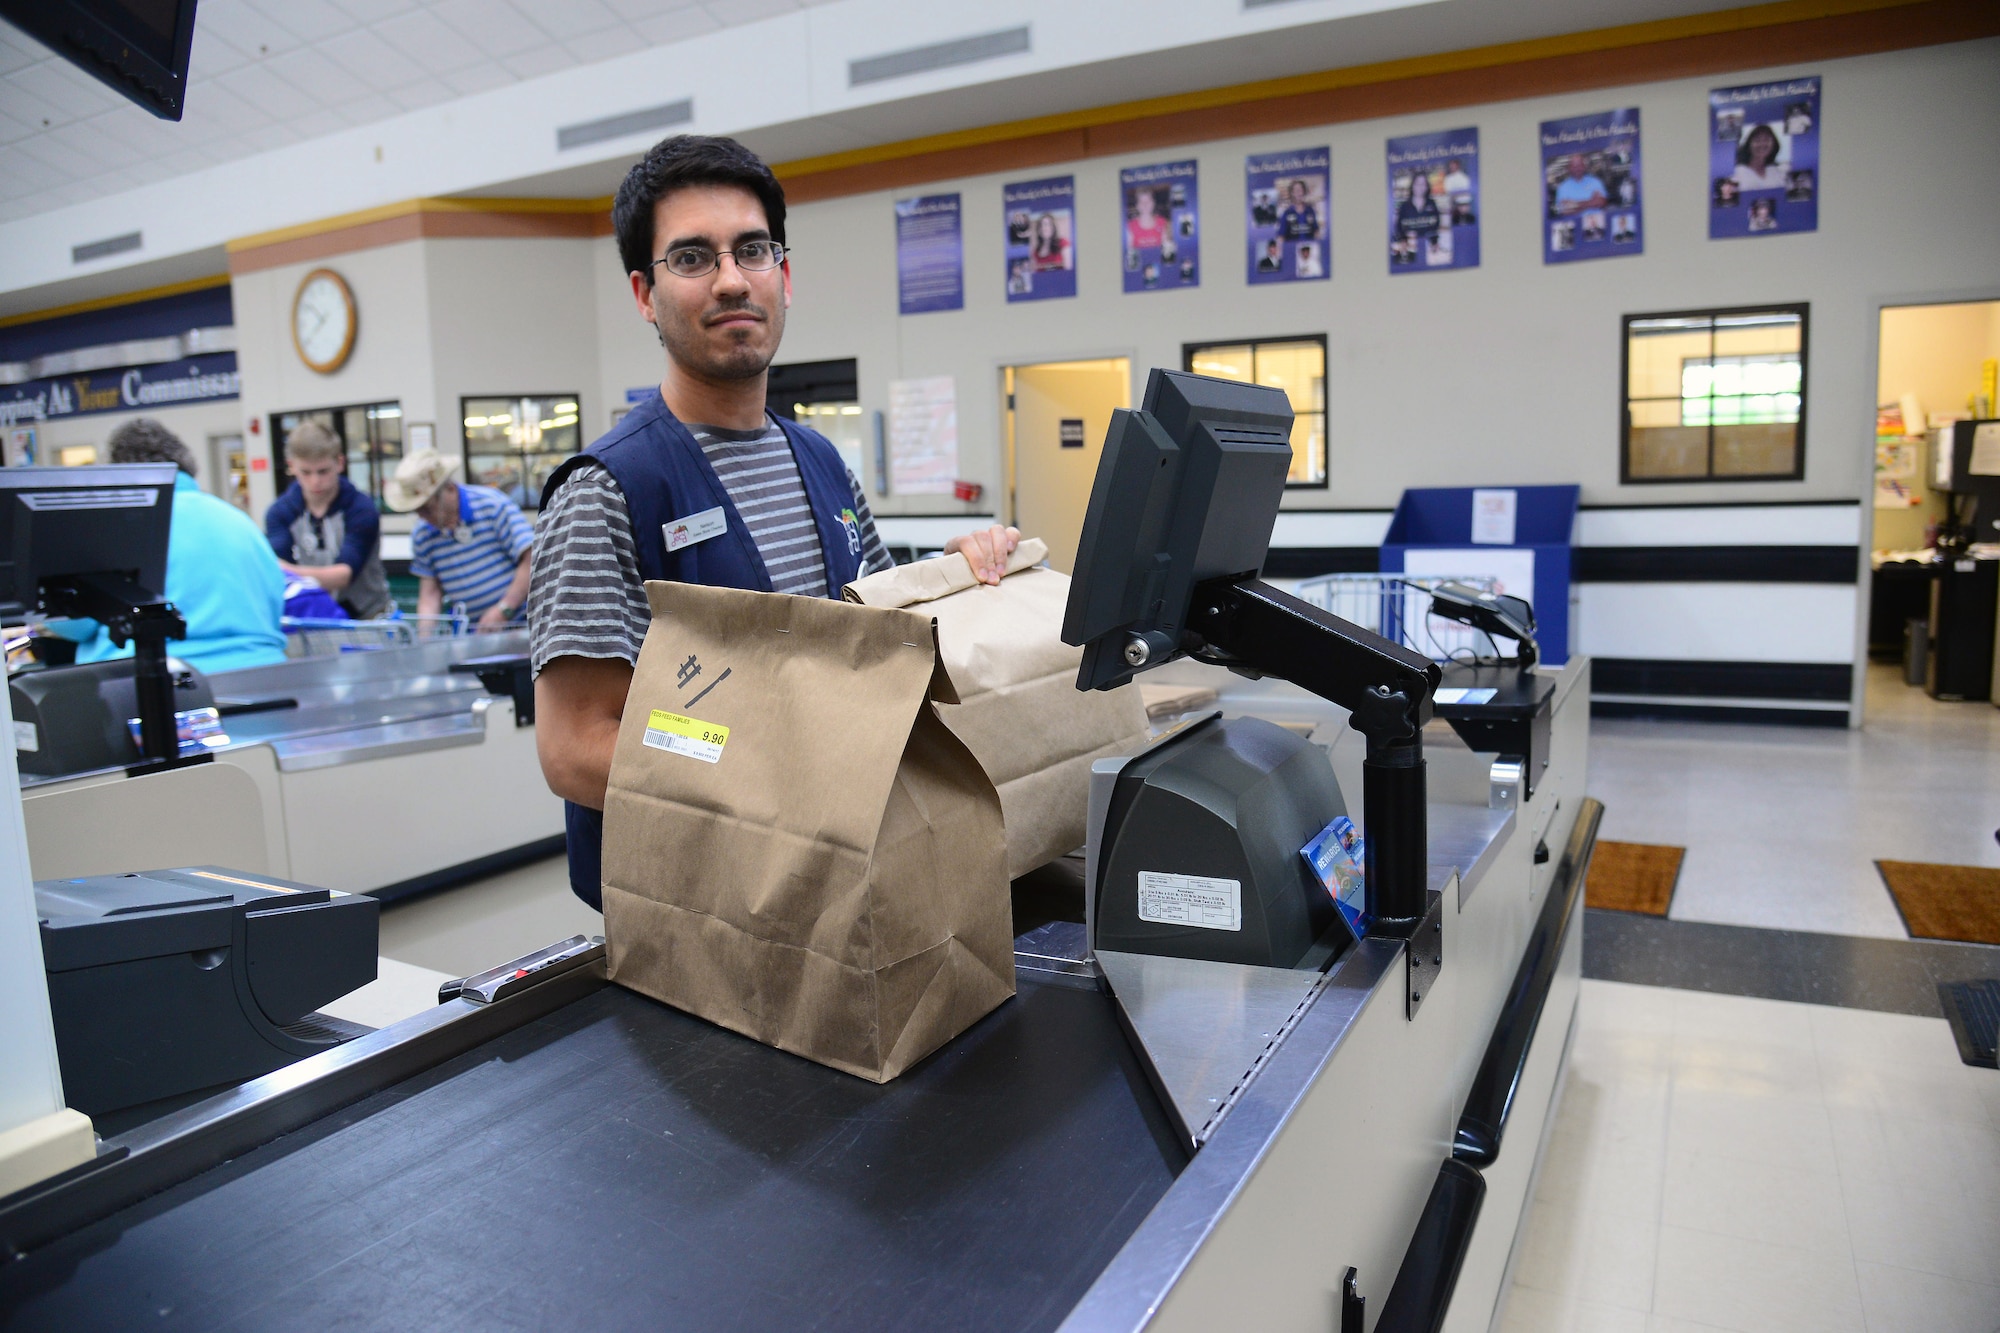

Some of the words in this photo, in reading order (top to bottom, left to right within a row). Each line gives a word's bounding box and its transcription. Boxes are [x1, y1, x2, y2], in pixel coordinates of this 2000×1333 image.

[49, 381, 73, 415] At
[73, 377, 120, 411] Your
[651, 710, 662, 718] FEDS
[672, 716, 691, 725] FAMILIES
[702, 731, 725, 745] 9.90
[1317, 843, 1341, 871] REWARDS
